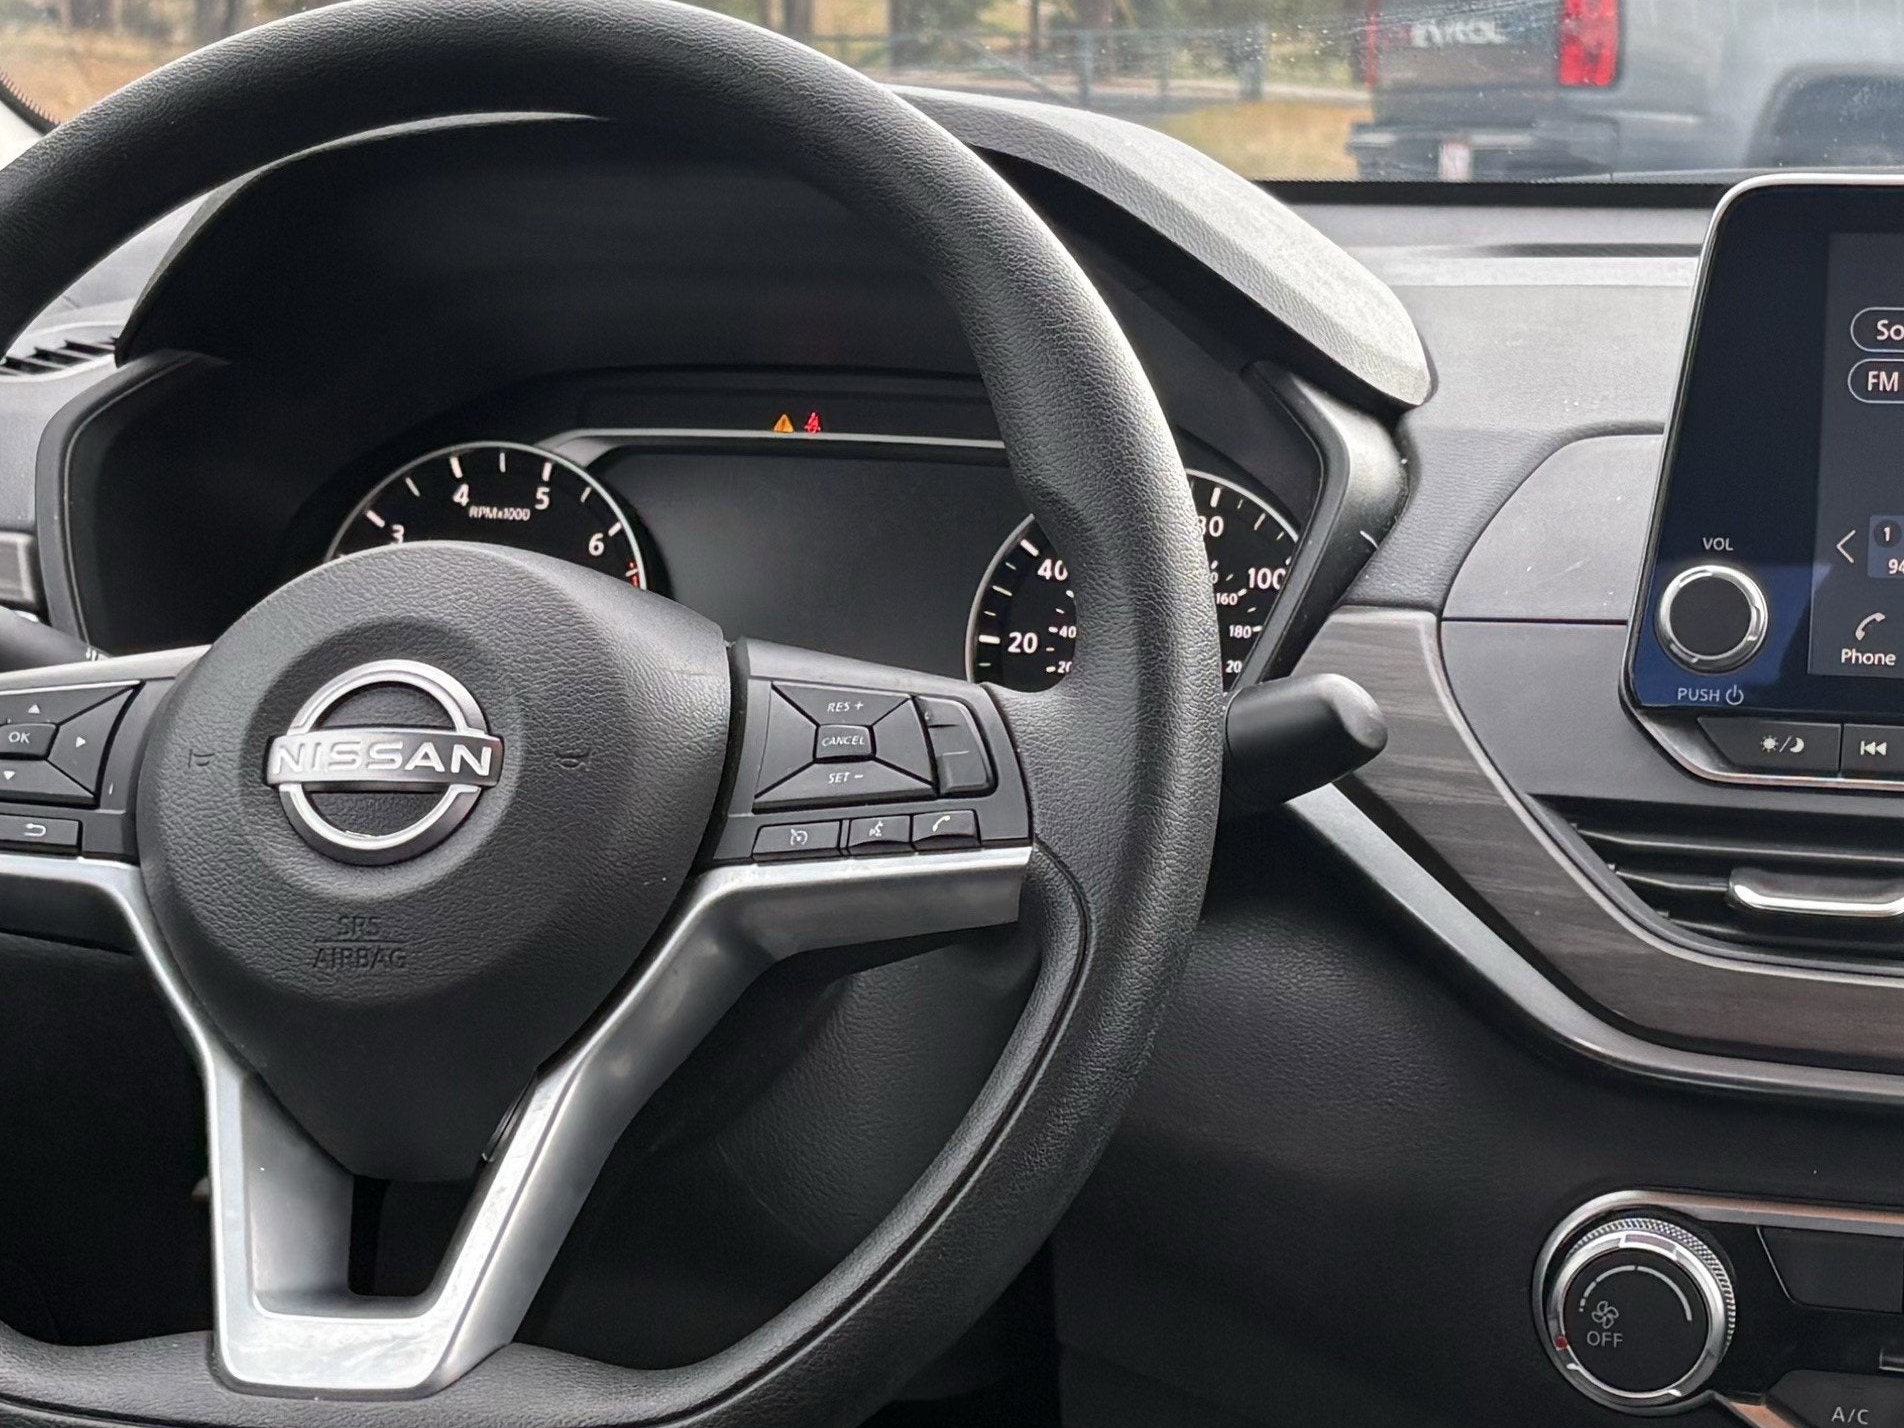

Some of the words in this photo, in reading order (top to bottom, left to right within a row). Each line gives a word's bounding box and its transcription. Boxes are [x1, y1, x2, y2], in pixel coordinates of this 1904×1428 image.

[1867, 370, 1899, 393] FM
[451, 483, 469, 507] 4
[534, 486, 550, 510] 5
[391, 524, 405, 544] 3
[1883, 527, 1892, 542] 1
[588, 532, 604, 556] 6
[1702, 537, 1734, 551] VOL
[1037, 558, 1069, 581] 40
[1216, 592, 1238, 605] 160
[1059, 625, 1077, 638] 40
[1229, 624, 1252, 639] 180
[1007, 631, 1039, 654] 20
[1841, 648, 1896, 667] Phone
[1677, 687, 1720, 702] PUSH
[826, 700, 851, 713] RES
[8, 730, 30, 745] OK
[821, 734, 866, 747] CANCEL
[274, 738, 494, 778] NISSAN
[827, 771, 851, 784] SET
[337, 915, 382, 935] SRS
[312, 946, 407, 969] AIRBAG
[1586, 1330, 1623, 1348] OFF
[1831, 1406, 1868, 1425] A/C
